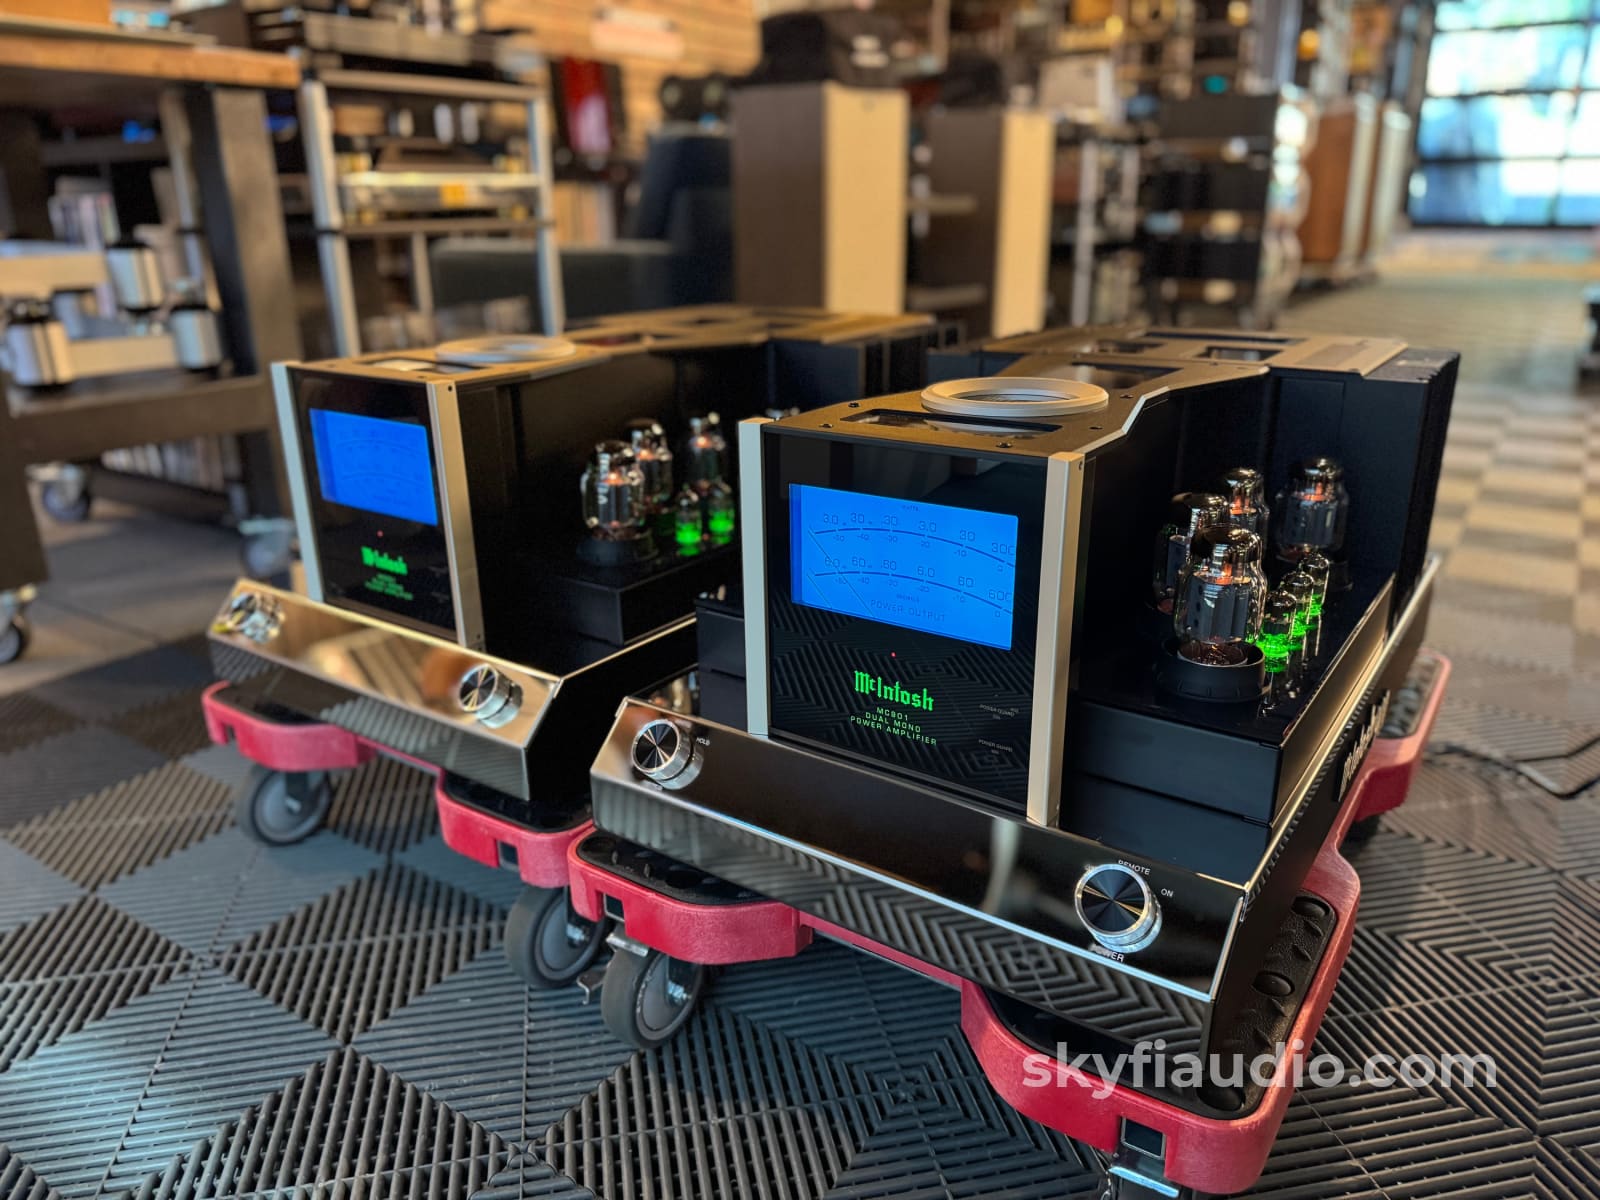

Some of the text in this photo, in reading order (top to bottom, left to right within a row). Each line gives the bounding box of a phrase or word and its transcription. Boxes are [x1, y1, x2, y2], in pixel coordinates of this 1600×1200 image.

[959, 530, 976, 542] 30
[854, 670, 934, 711] McIntosh
[850, 715, 937, 746] POWER AMPLIFIER
[865, 711, 921, 733] DUAL MONO
[1161, 888, 1174, 898] ON
